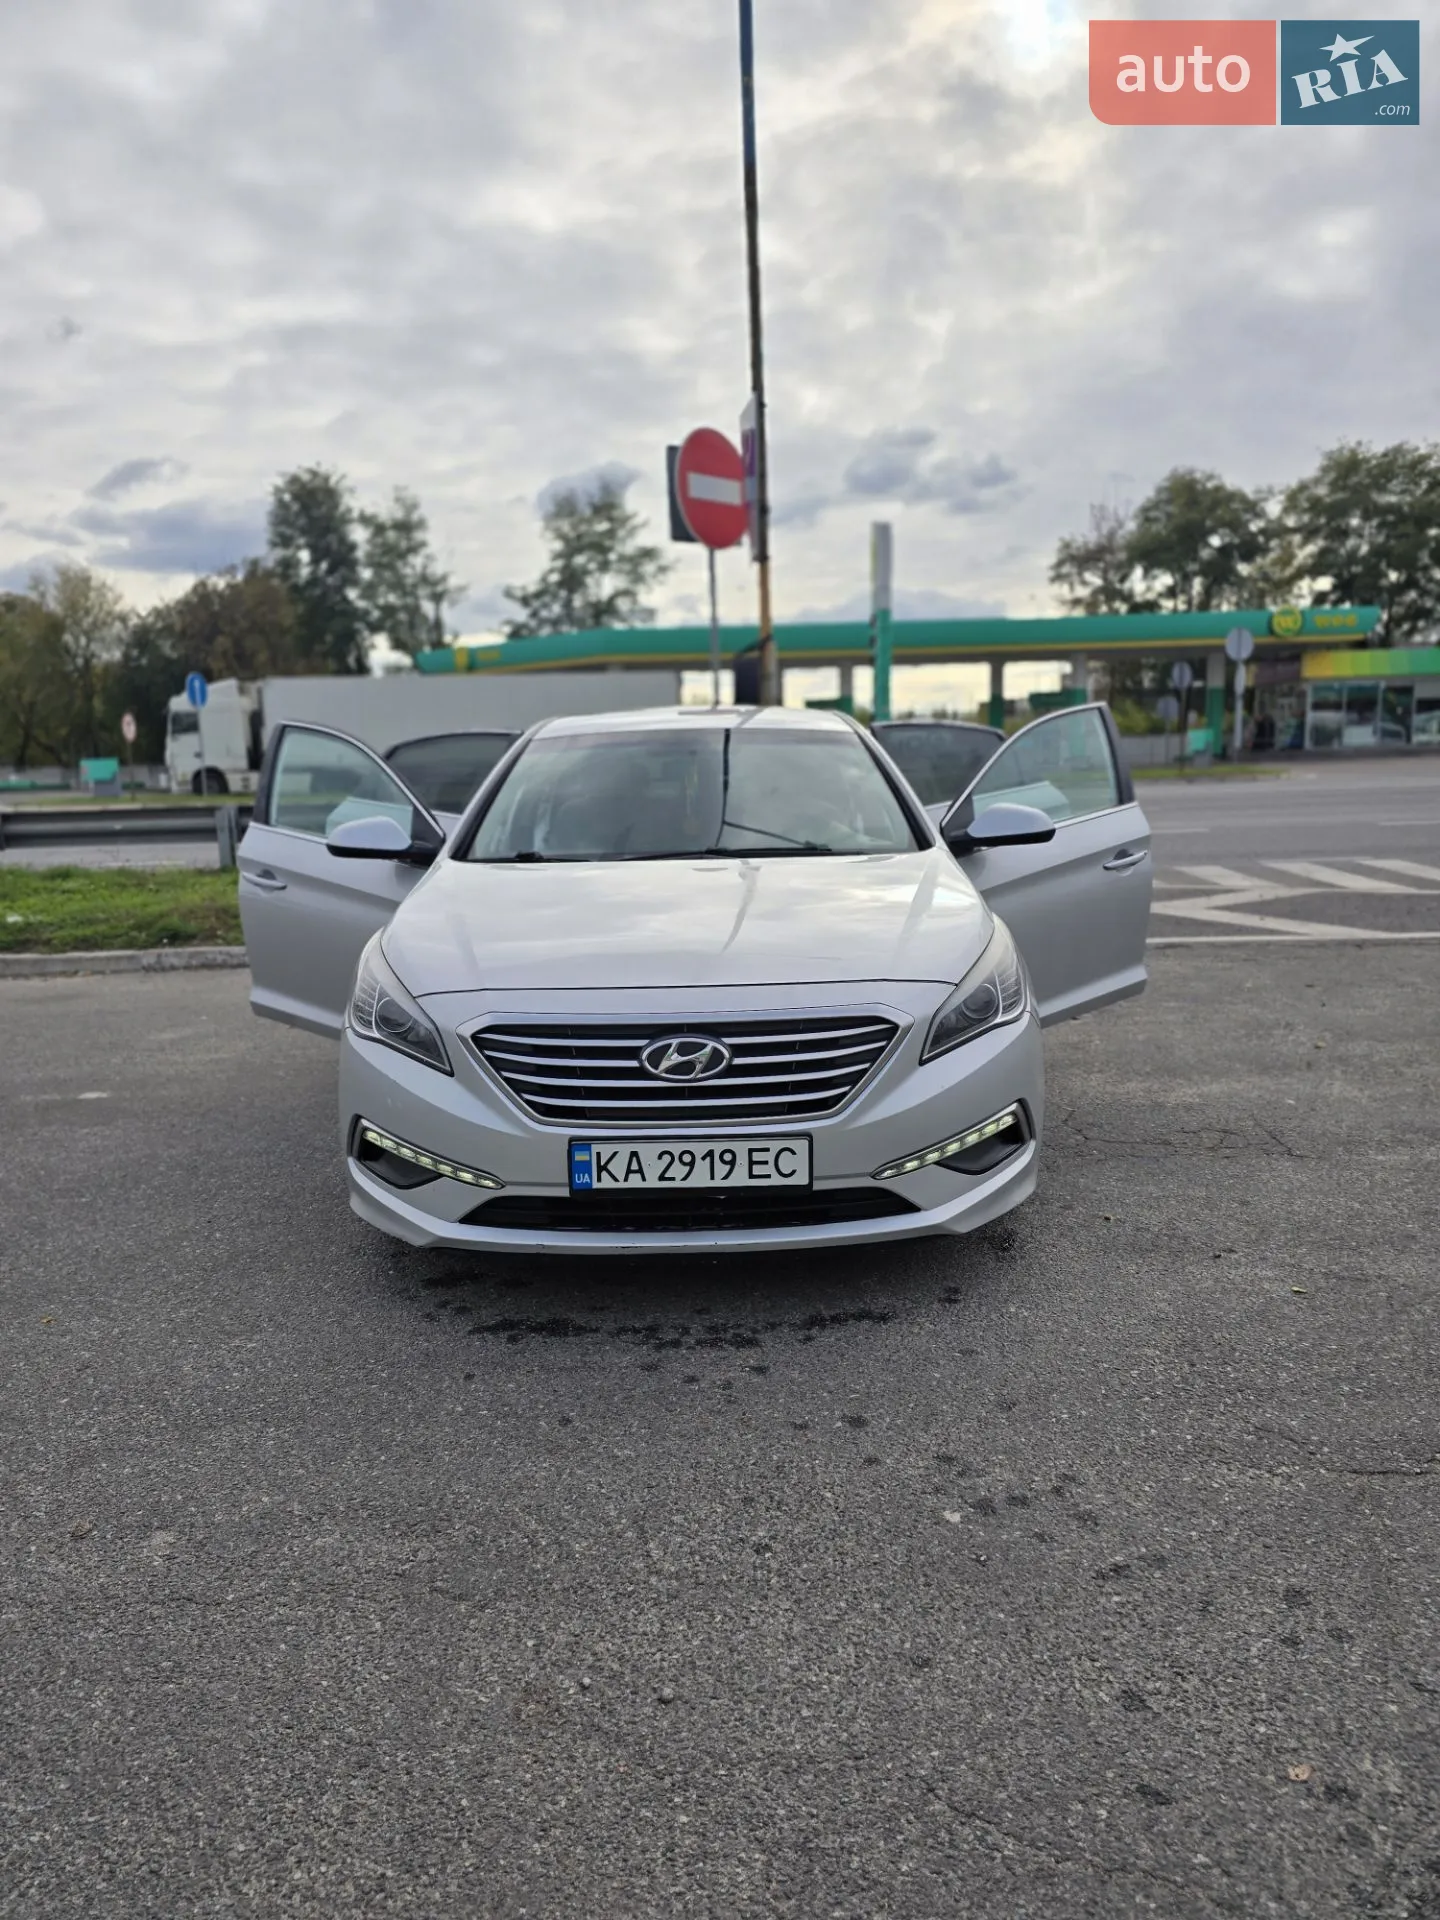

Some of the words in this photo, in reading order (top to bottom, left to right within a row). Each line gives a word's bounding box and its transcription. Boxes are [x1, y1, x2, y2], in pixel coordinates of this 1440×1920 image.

[596, 1150, 647, 1183] KA
[657, 1149, 737, 1182] 2919
[748, 1147, 798, 1179] EC
[575, 1173, 591, 1184] UA
